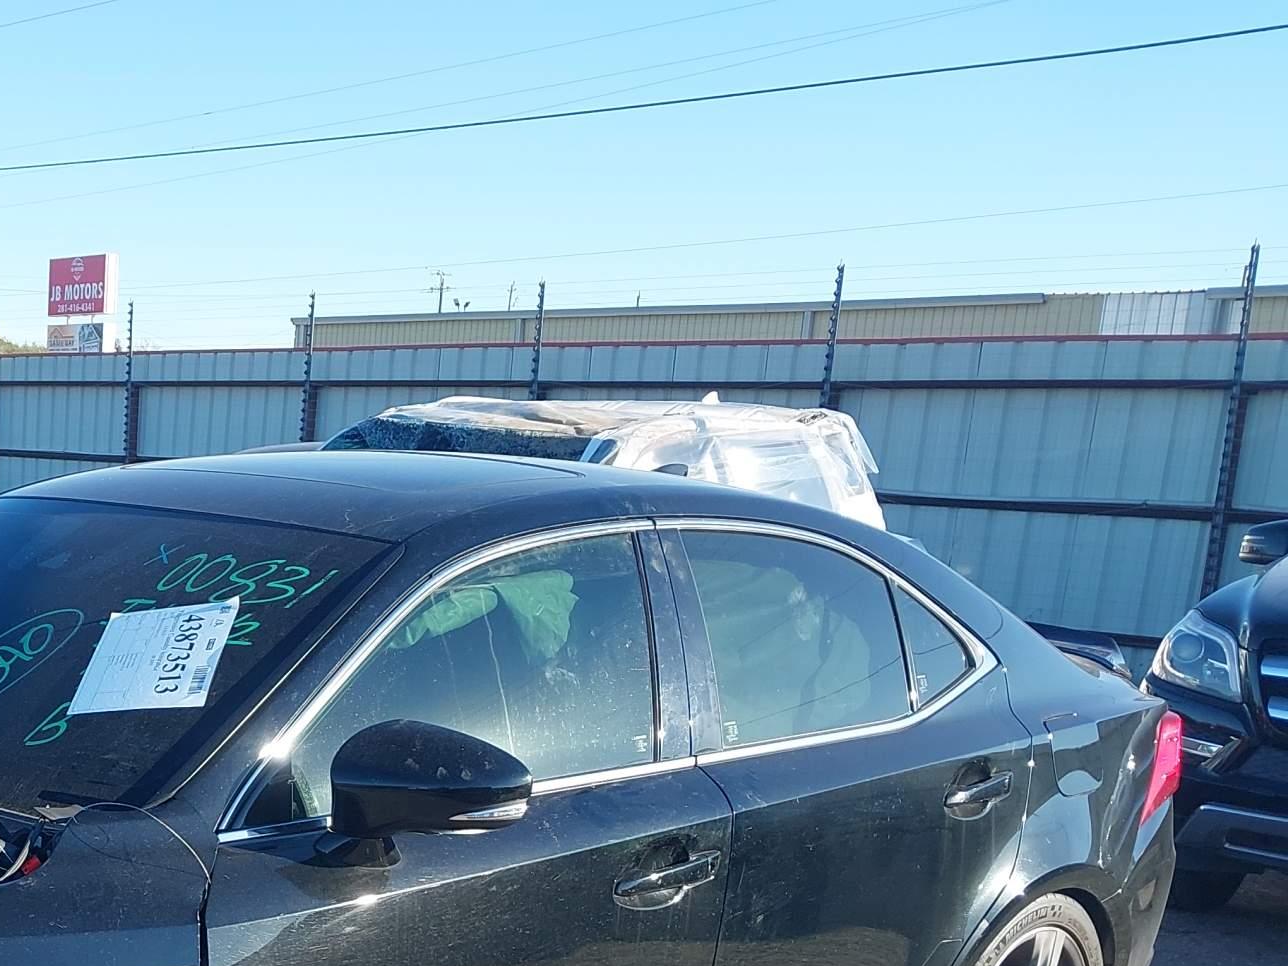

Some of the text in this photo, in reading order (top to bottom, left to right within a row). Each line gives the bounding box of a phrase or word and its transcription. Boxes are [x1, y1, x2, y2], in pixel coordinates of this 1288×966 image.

[50, 281, 103, 302] JB MOTORS
[153, 614, 205, 695] 43873513
